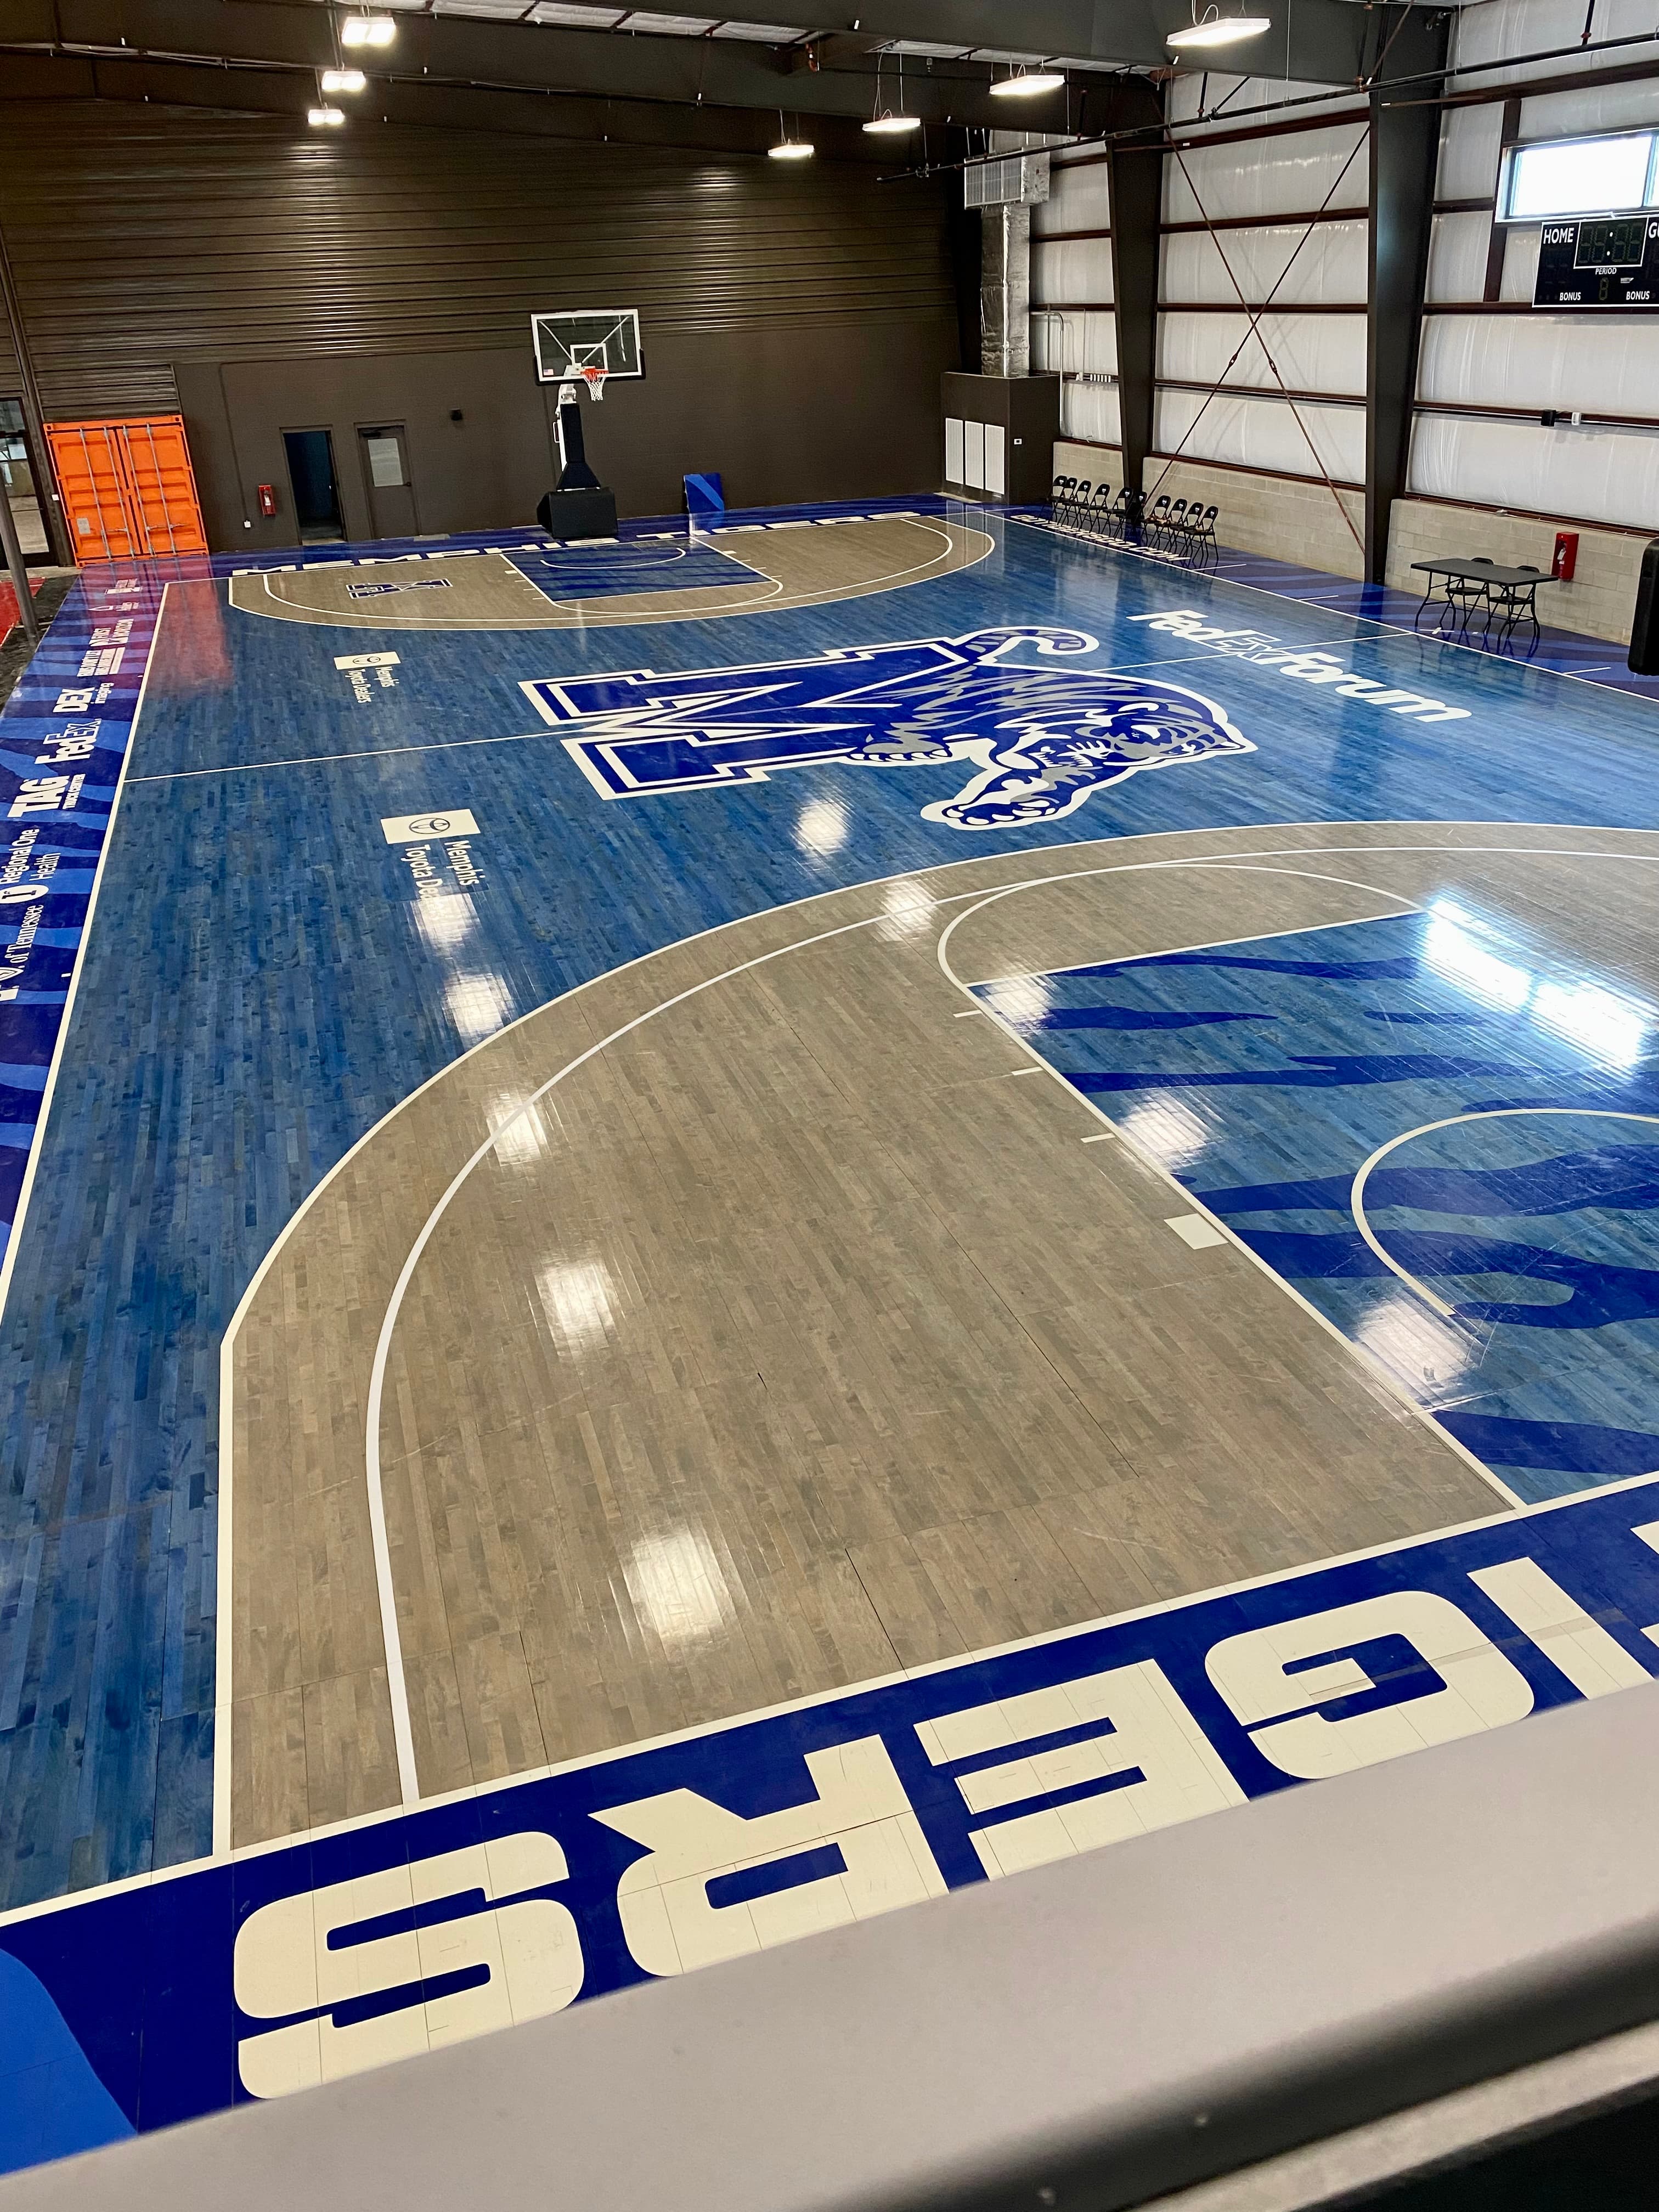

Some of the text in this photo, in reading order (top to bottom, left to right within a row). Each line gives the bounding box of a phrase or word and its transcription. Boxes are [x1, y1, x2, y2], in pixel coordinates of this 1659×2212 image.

[1543, 227, 1574, 244] HOME
[1559, 292, 1581, 301] BONUS
[1626, 291, 1650, 300] BONUS
[232, 511, 921, 575] MEMPHIS TIGERS
[91, 627, 111, 640] FIRST
[112, 618, 134, 637] HORIZON
[91, 682, 114, 704] imaging
[345, 669, 375, 703] Toyota Dealers
[374, 666, 400, 687] Memphis
[53, 687, 95, 713] DEX
[34, 719, 101, 764] FedEx
[7, 775, 70, 817] TAG
[63, 774, 86, 810] TRUCK CENTER
[0, 828, 40, 884] Regional One
[29, 852, 61, 881] Health
[400, 844, 436, 878] Toyota
[444, 840, 486, 886] Memphis
[4, 905, 44, 963] of Tennessee
[234, 1521, 1659, 2100] IGERS
